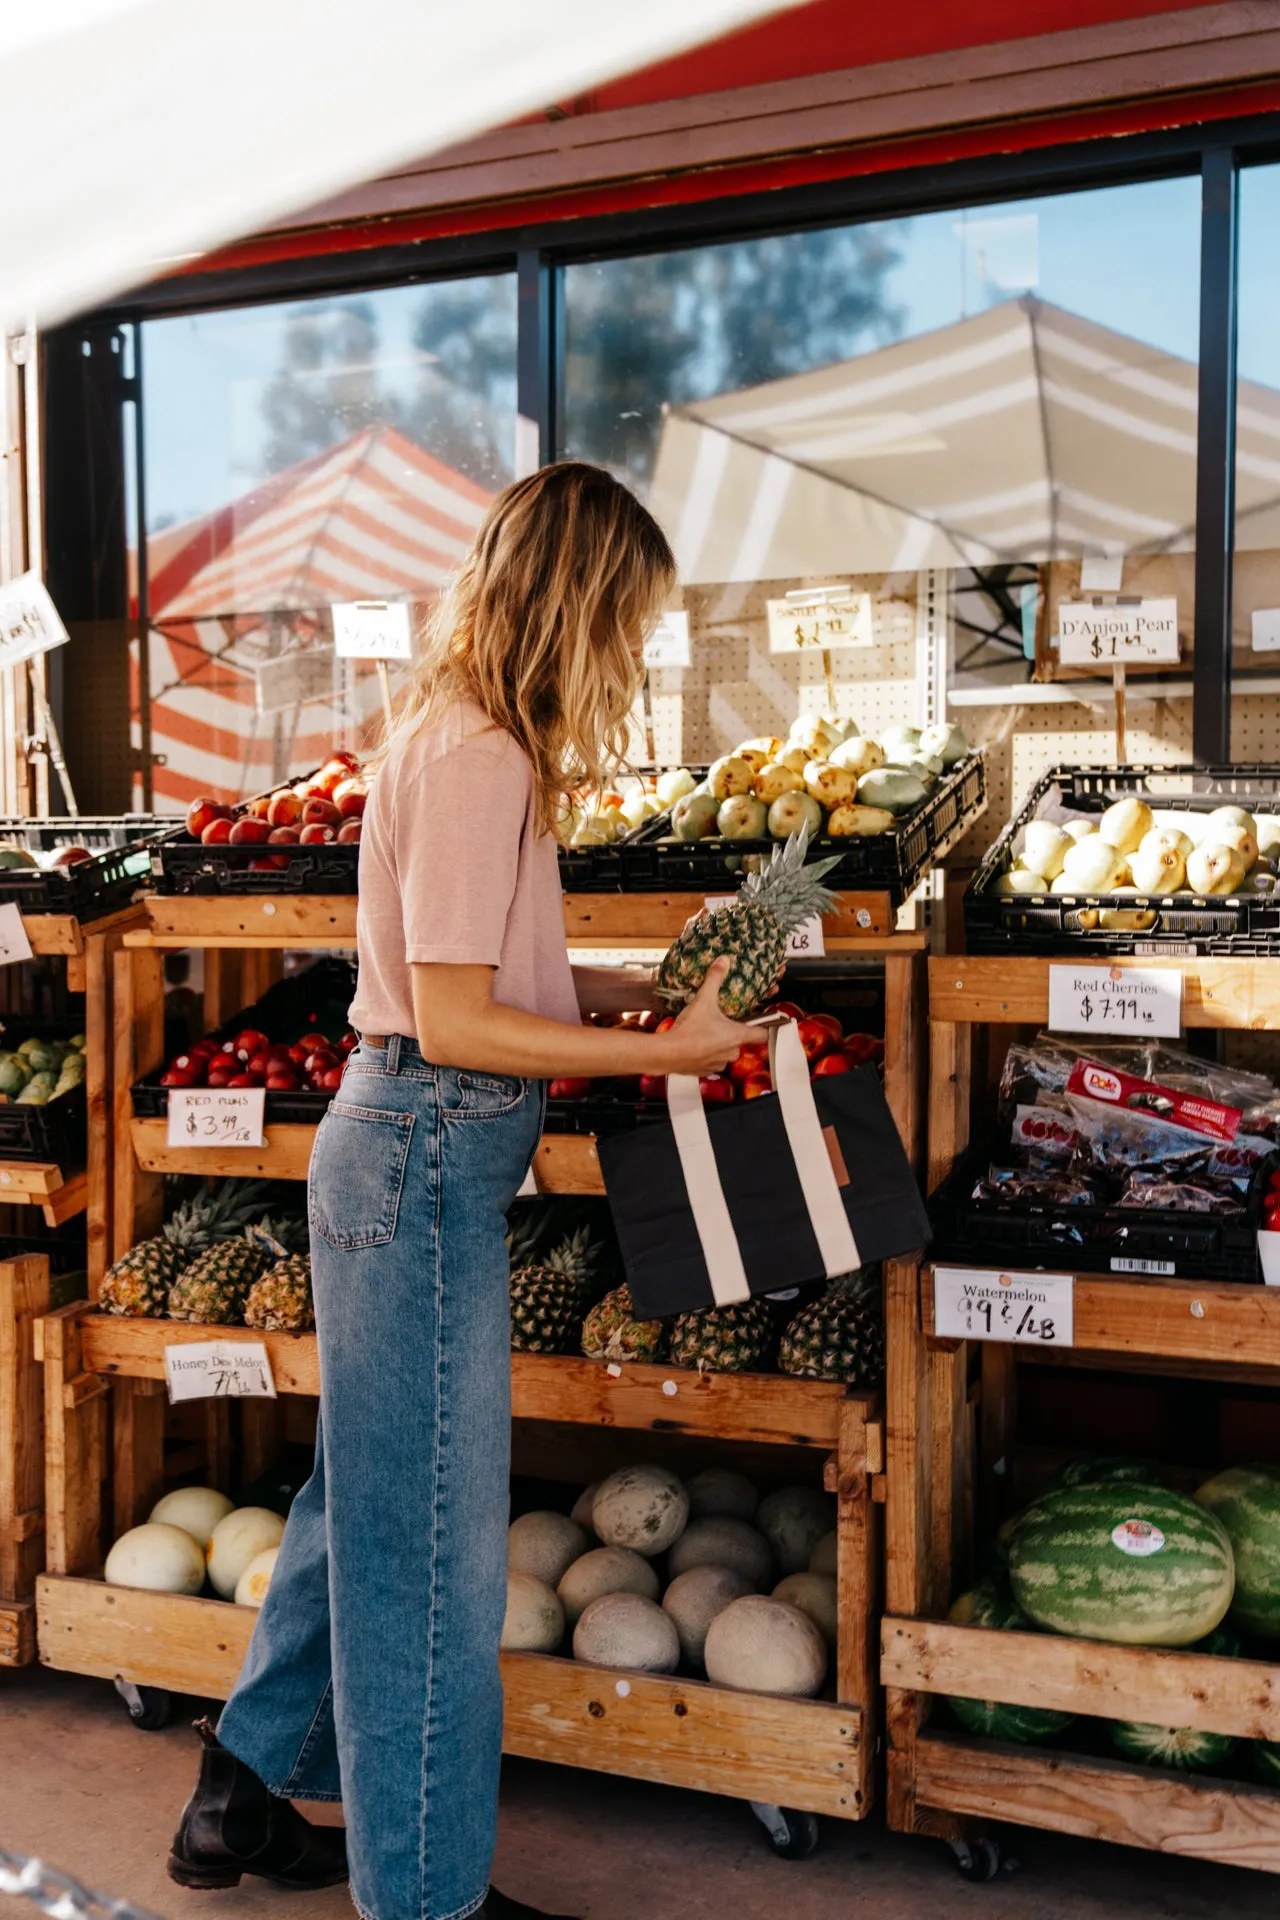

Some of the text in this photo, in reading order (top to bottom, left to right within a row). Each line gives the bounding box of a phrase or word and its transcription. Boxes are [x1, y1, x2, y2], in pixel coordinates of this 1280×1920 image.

[1061, 616, 1175, 638] D'Anjou Pear
[791, 934, 809, 950] LB
[1073, 979, 1158, 995] Red Cherries
[1089, 1073, 1118, 1090] Dole
[185, 1095, 212, 1107] RED
[962, 1283, 1047, 1303] Watermelon
[172, 1359, 209, 1371] Honey
[234, 1356, 266, 1369] Melon
